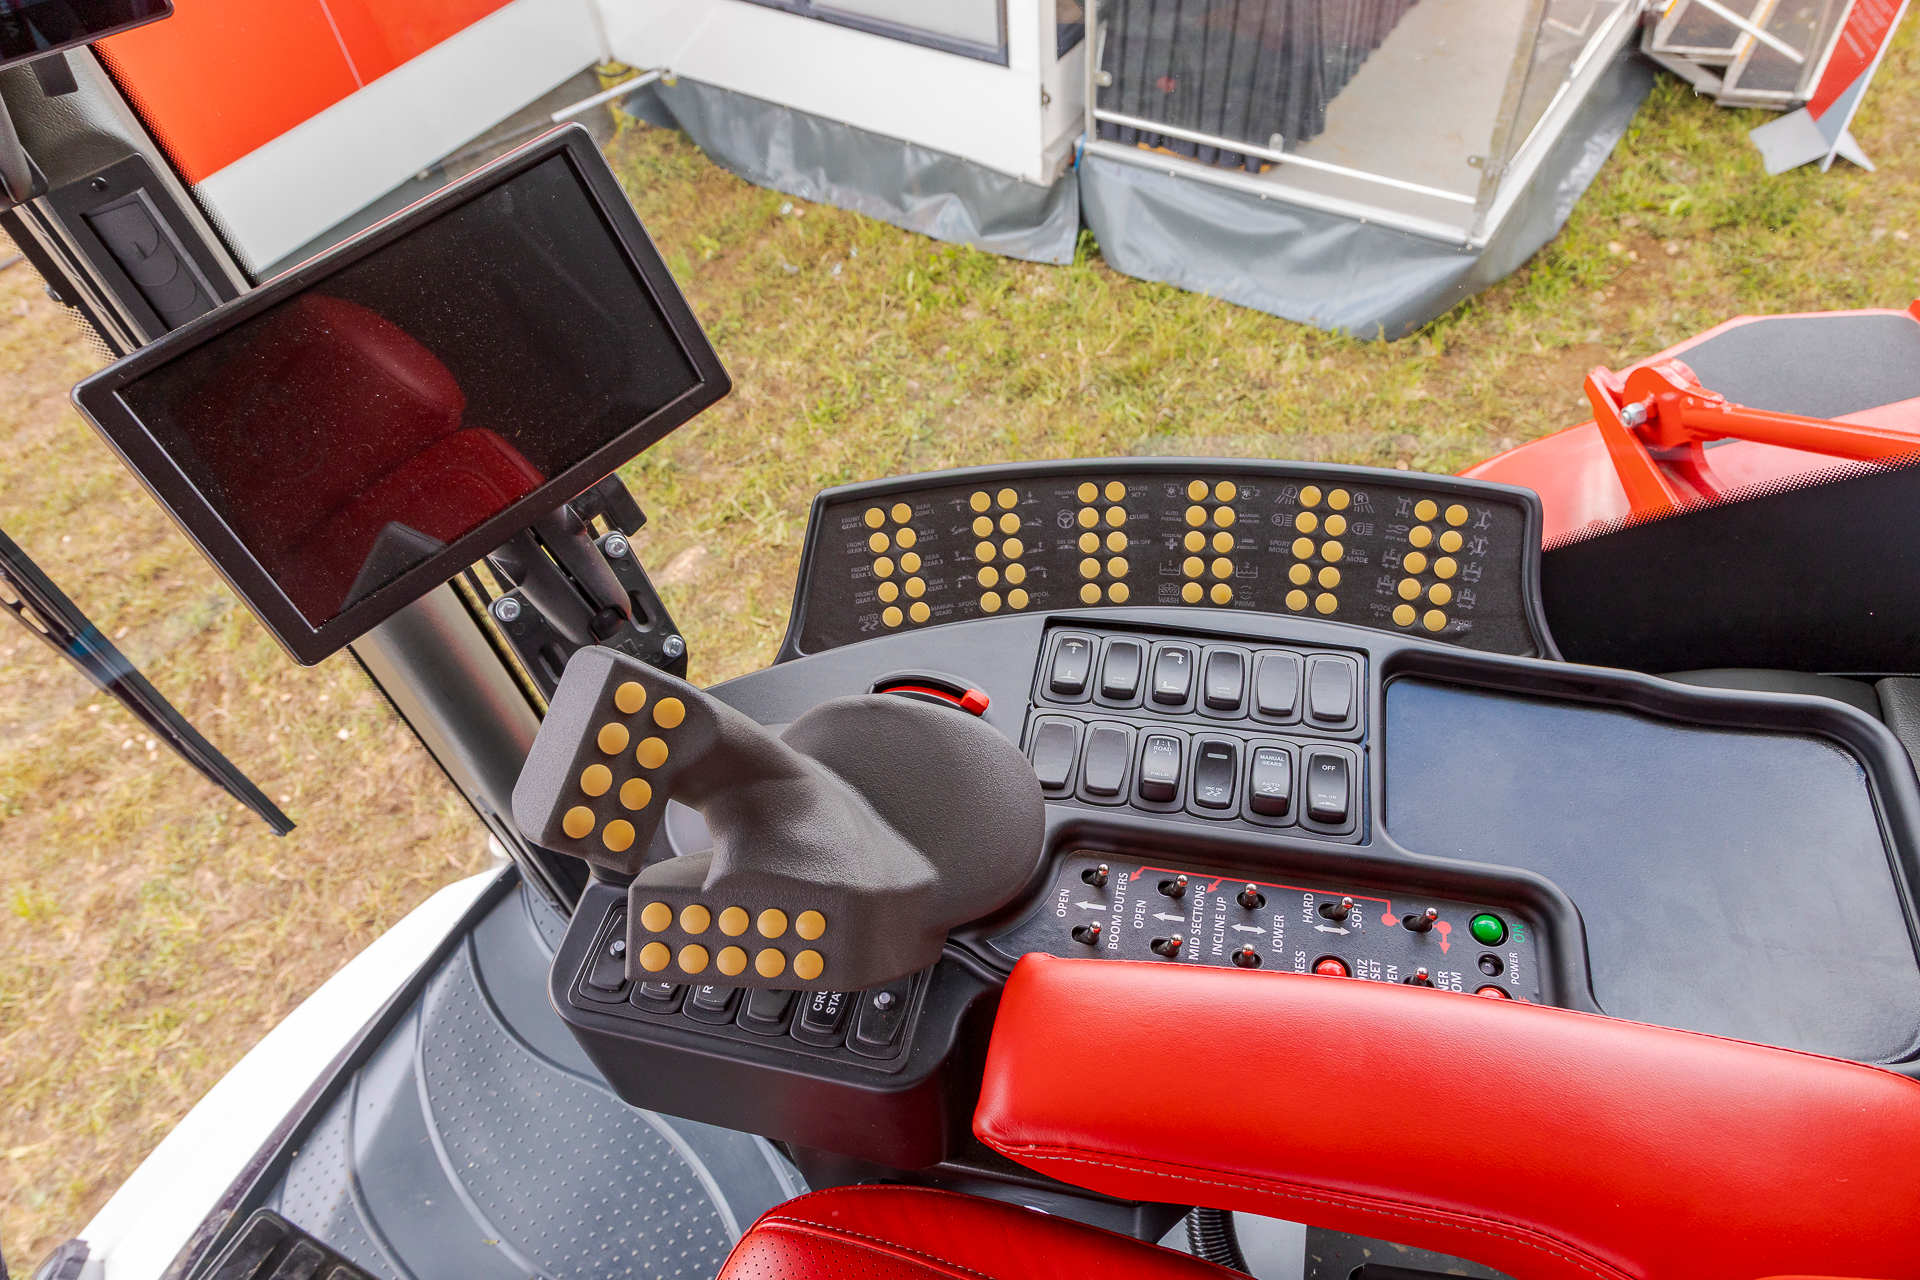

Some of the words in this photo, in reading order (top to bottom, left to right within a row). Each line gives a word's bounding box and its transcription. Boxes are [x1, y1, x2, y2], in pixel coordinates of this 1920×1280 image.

[1346, 556, 1368, 564] MODE
[1158, 596, 1180, 604] WASH
[1234, 599, 1256, 607] PRIME
[1259, 754, 1285, 762] MANUAL
[1056, 888, 1070, 918] OPEN
[1113, 872, 1129, 913] OUTERS
[1215, 896, 1227, 912] UP
[1133, 899, 1147, 929] OPEN
[1190, 884, 1206, 936] SECTIONS
[1302, 893, 1314, 924] HARD
[1107, 914, 1123, 950] BOOM
[1211, 913, 1226, 956] INCLINE
[1272, 914, 1285, 954] LOWER
[1512, 923, 1526, 943] ON
[1188, 936, 1201, 961] MID
[1508, 951, 1520, 986] POWER
